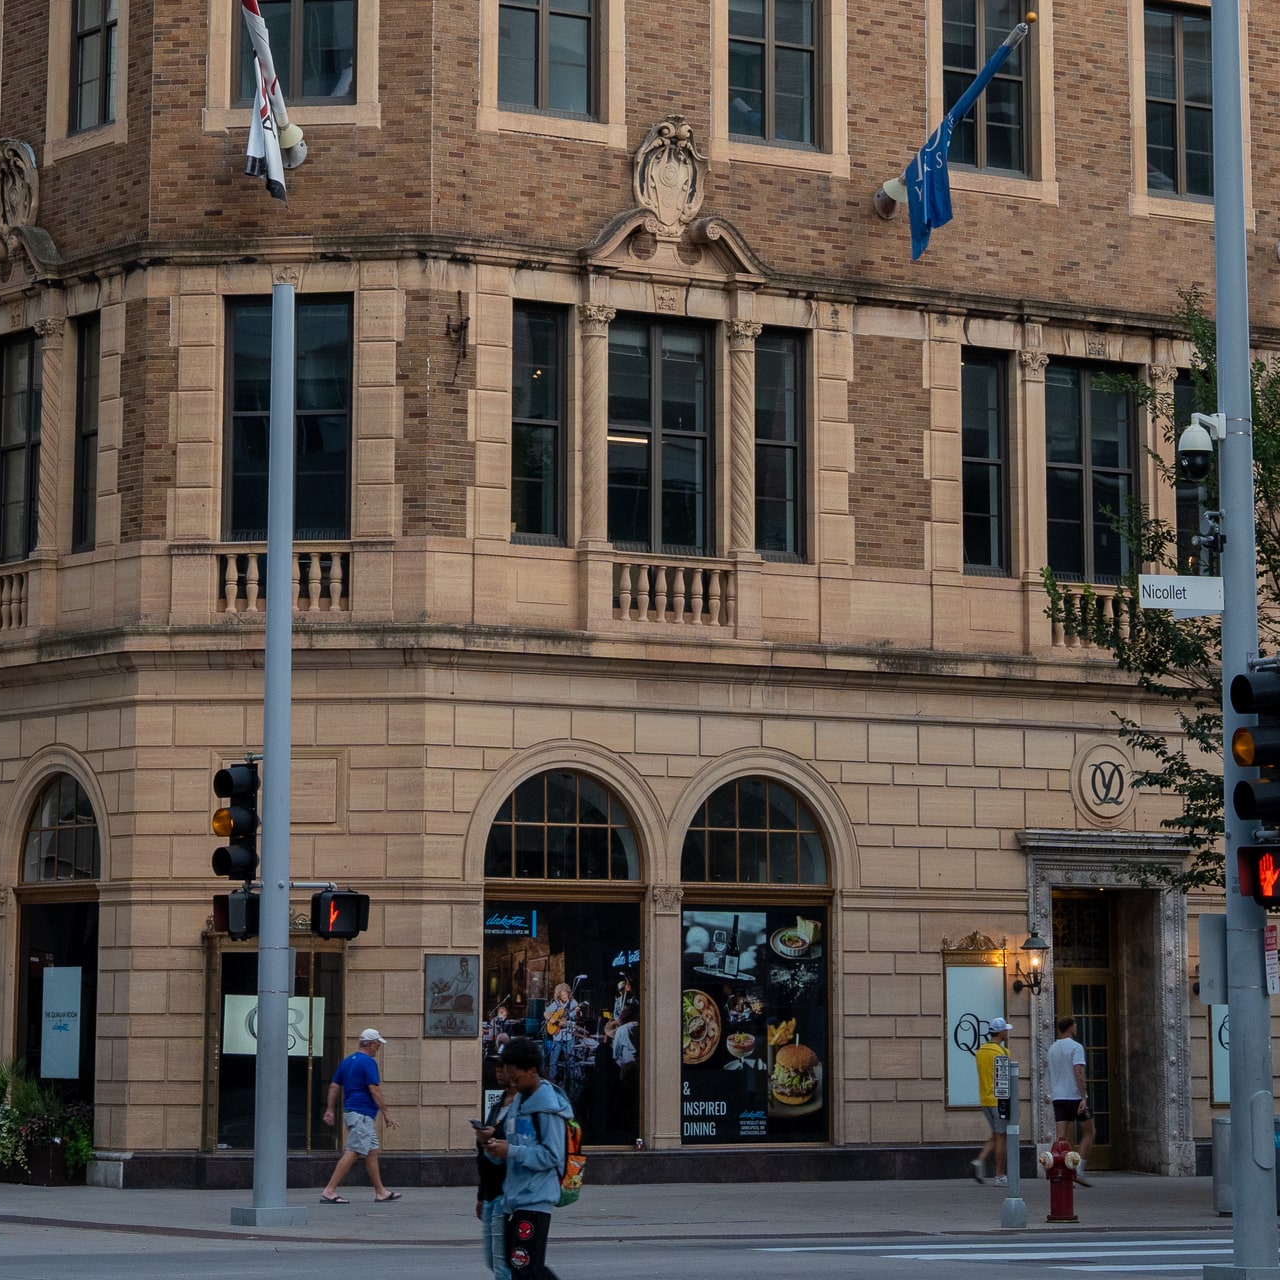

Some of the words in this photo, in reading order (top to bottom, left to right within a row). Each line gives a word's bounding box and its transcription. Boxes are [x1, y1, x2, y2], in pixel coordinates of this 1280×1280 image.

[1142, 584, 1187, 600] Nicollet
[485, 913, 529, 929] dakota
[683, 1081, 691, 1095] &
[683, 1101, 727, 1116] INSPIRED
[683, 1122, 721, 1136] DINING
